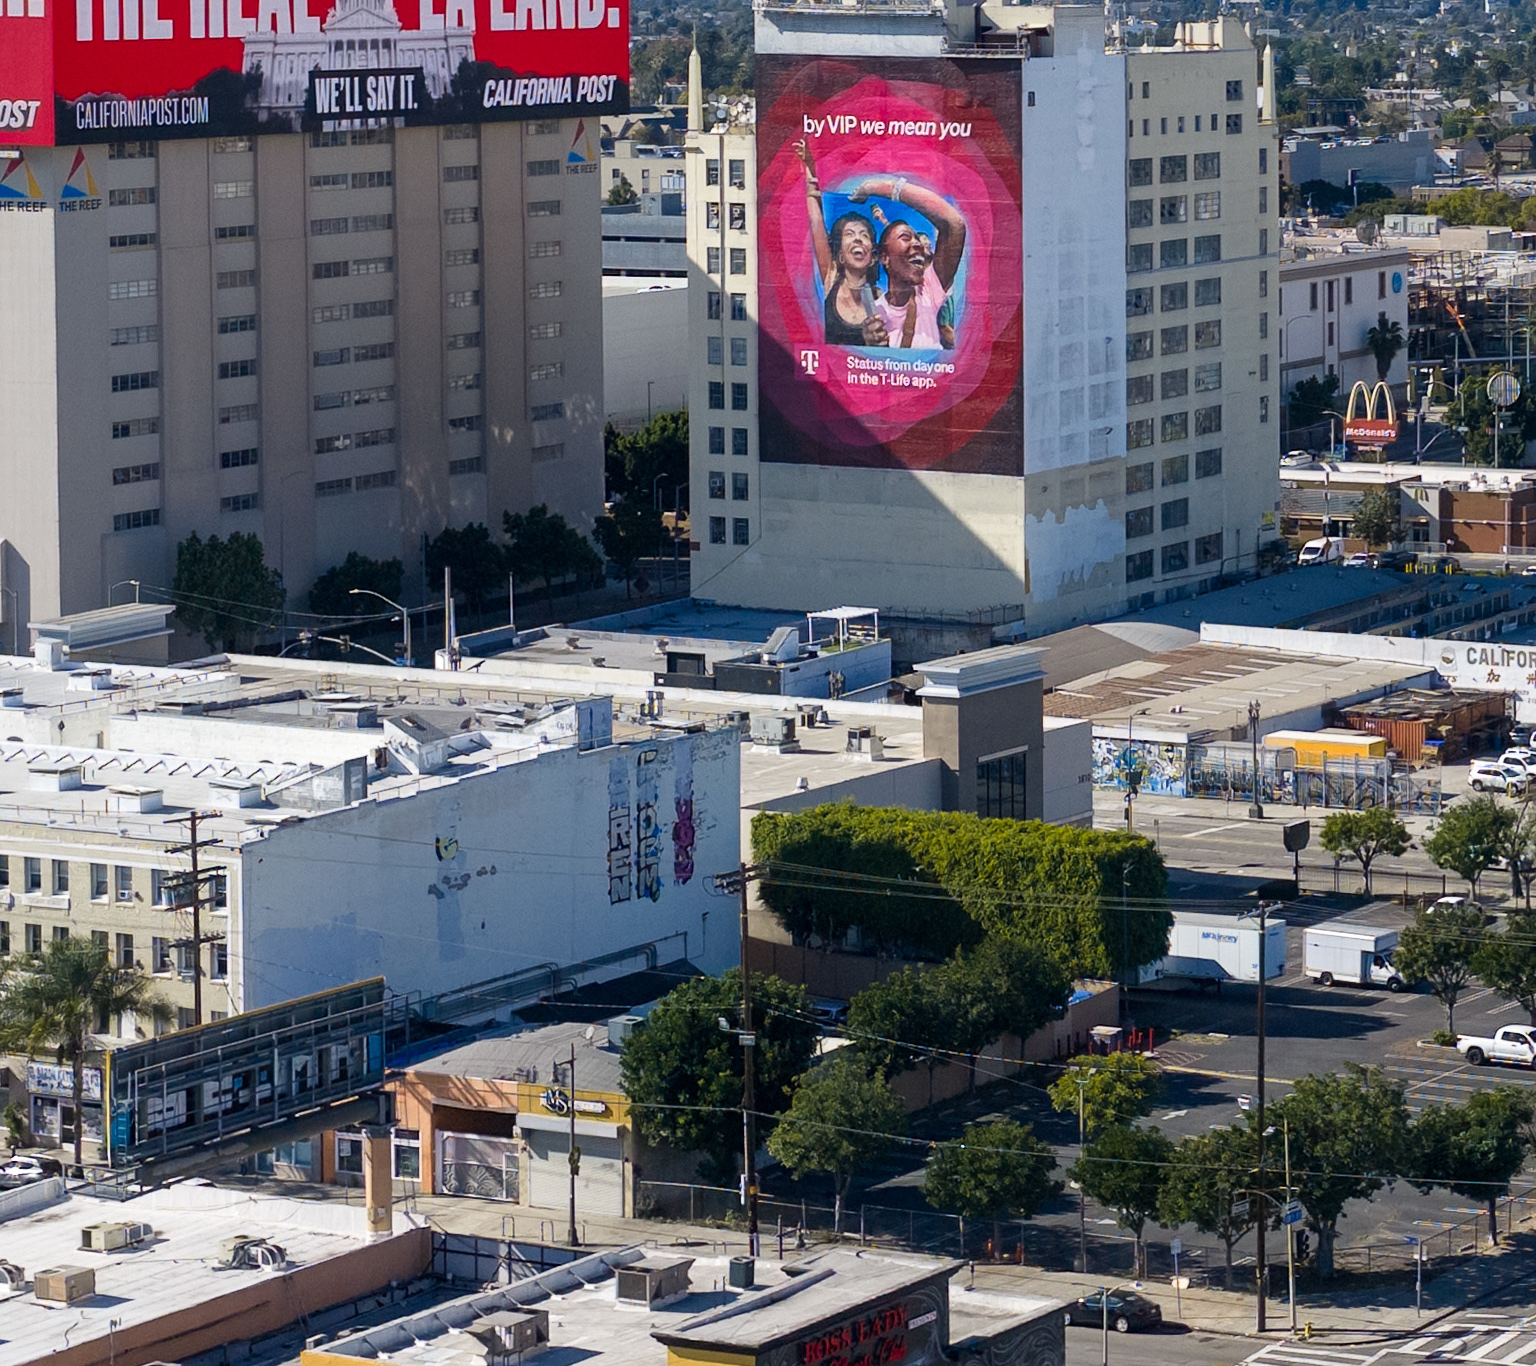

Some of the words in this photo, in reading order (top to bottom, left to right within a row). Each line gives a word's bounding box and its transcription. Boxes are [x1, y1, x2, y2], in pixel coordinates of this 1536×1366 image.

[314, 75, 362, 115] WE'LL
[366, 75, 396, 112] SAY
[399, 75, 418, 110] IT.
[482, 77, 571, 109] CALIFORNIA
[575, 75, 616, 105] POST
[76, 96, 210, 130] CALIFORNIAPOST.COM
[803, 114, 825, 138] by
[826, 115, 857, 134] VIP
[860, 120, 885, 135] we
[887, 121, 935, 136] mean
[939, 124, 972, 140] you
[565, 163, 580, 175] THE
[581, 163, 598, 174] REEF
[17, 201, 47, 212] REEF
[59, 200, 77, 212] THE
[79, 198, 102, 211] REEF
[846, 355, 884, 371] Status
[885, 357, 911, 371] from
[912, 357, 934, 374] day
[934, 363, 955, 373] one
[847, 372, 858, 384] in
[859, 372, 878, 385] the
[880, 373, 911, 386] T-Life
[912, 377, 937, 389] app.
[1345, 428, 1396, 437] McDonald's
